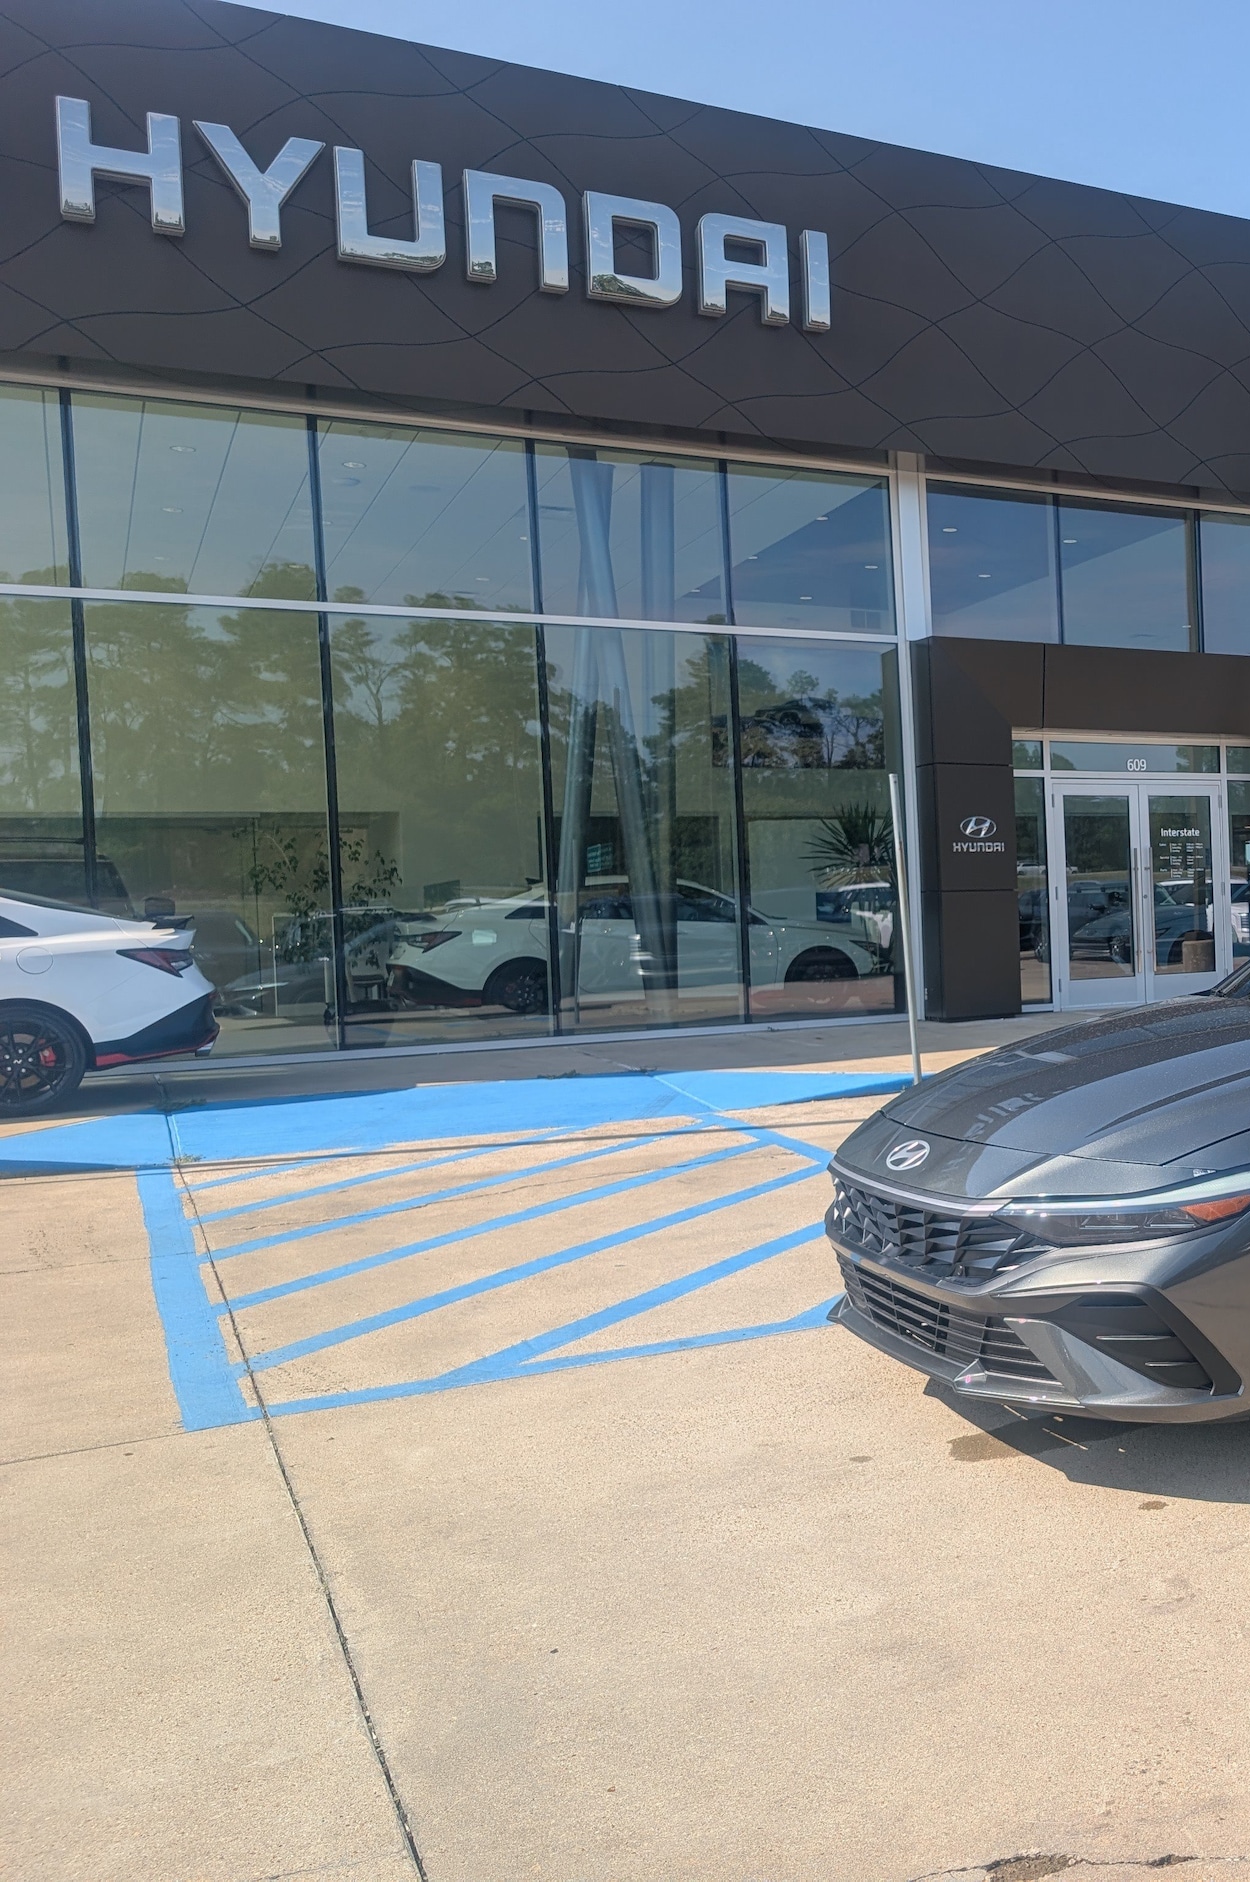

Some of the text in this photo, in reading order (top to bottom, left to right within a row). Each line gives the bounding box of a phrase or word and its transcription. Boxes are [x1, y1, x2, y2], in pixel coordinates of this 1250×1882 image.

[55, 95, 831, 333] HYUNDAI
[1127, 758, 1147, 771] 609
[1160, 827, 1200, 837] Interstate
[952, 841, 1005, 853] HYUNDAI
